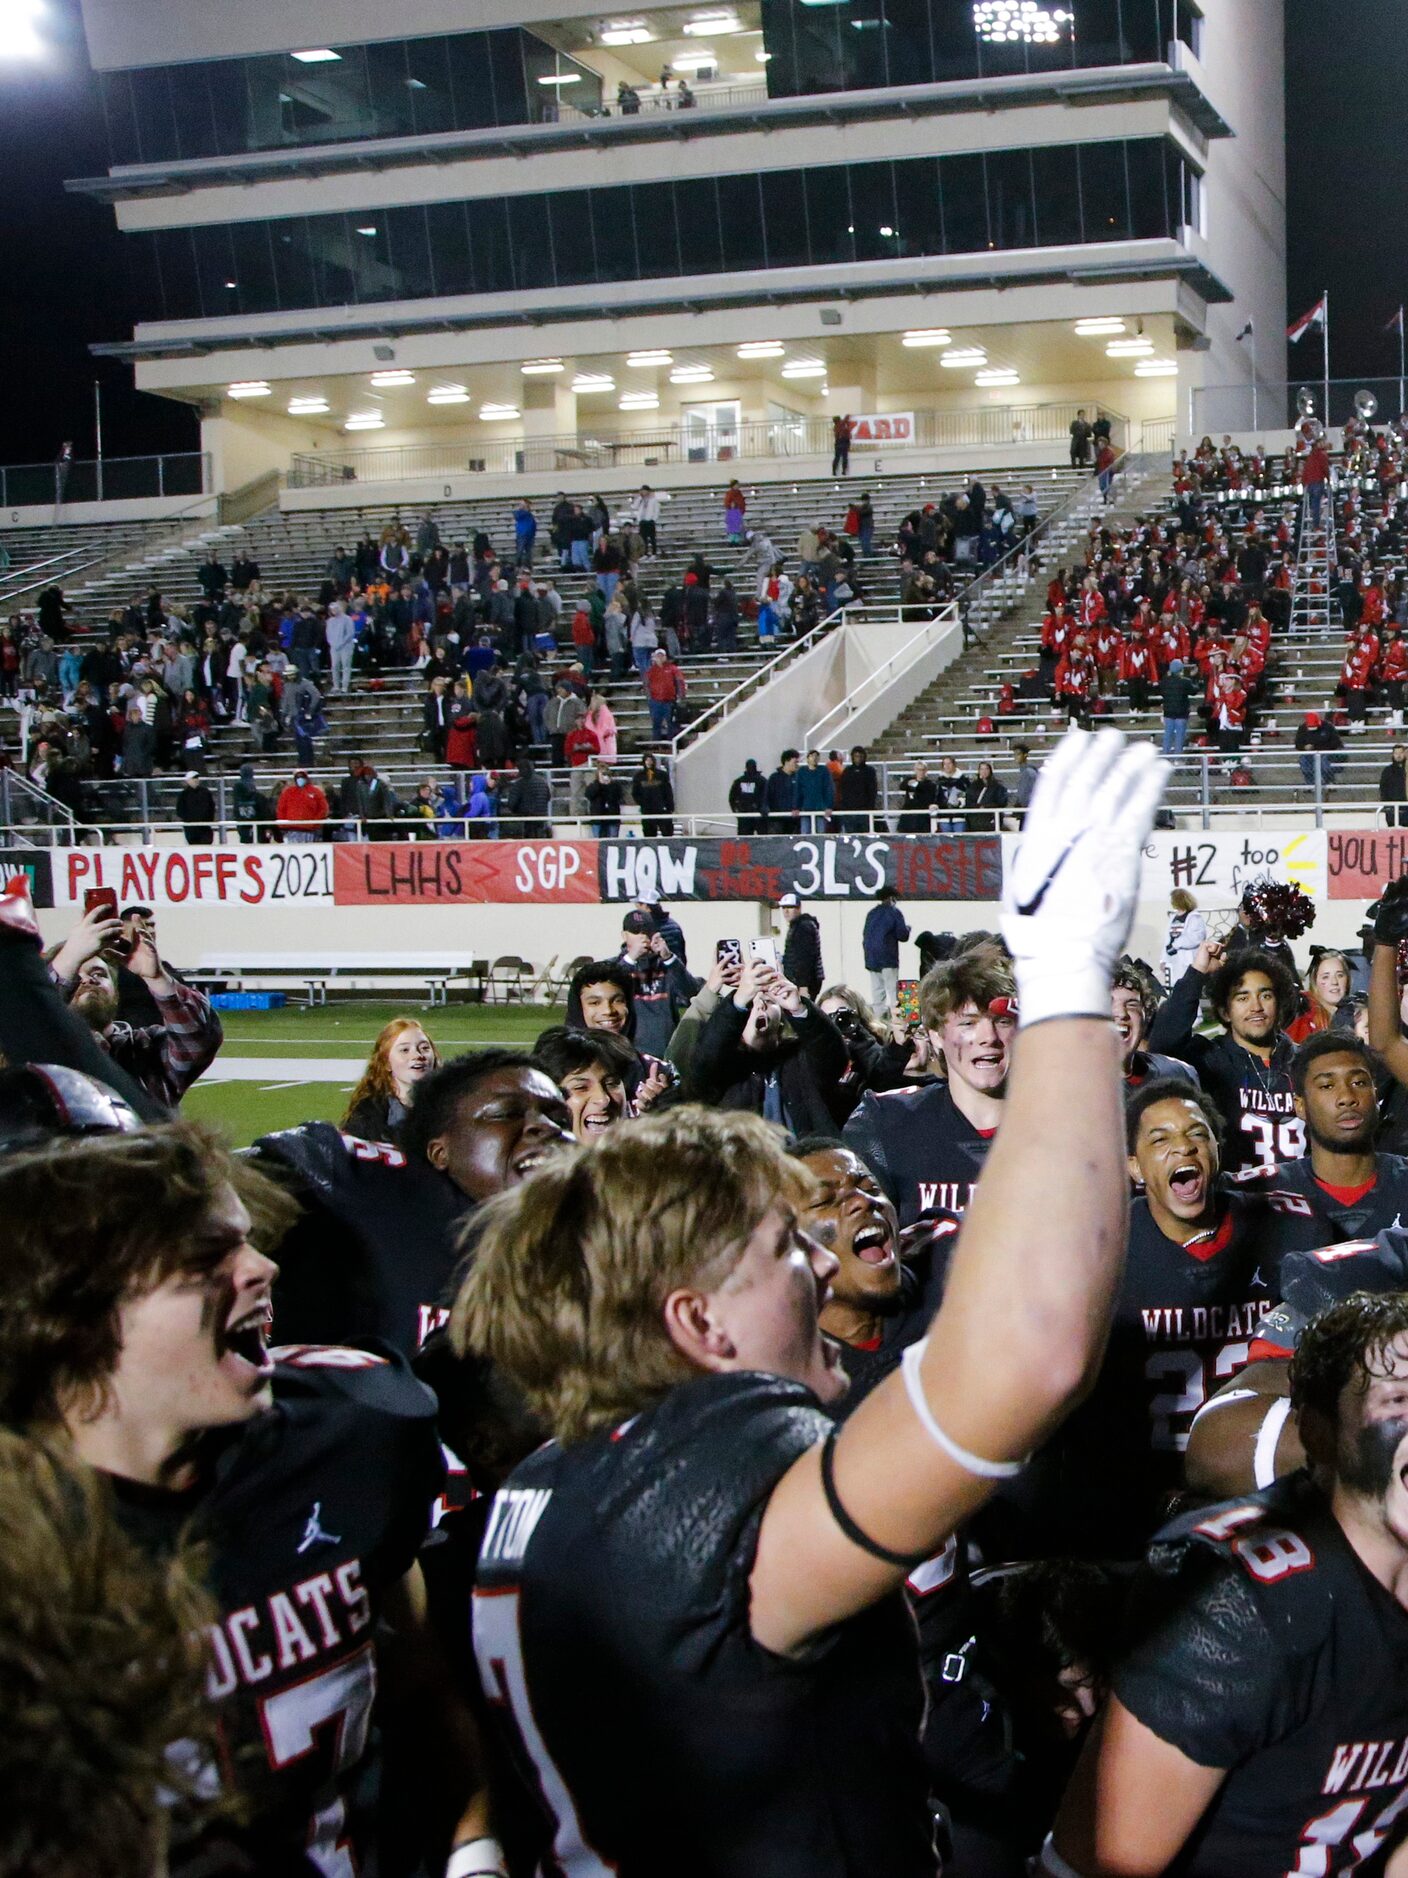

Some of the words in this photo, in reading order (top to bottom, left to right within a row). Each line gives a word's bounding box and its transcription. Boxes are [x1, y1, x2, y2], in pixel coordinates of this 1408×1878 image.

[874, 459, 883, 472] E
[11, 511, 20, 523] C
[68, 852, 266, 904] PLAYOFFS
[270, 852, 334, 899] 2021
[365, 850, 463, 896] LHHS
[515, 845, 581, 893] SGP
[606, 844, 698, 898] HOW
[793, 839, 889, 895] 3L'S
[1170, 843, 1217, 887] #2
